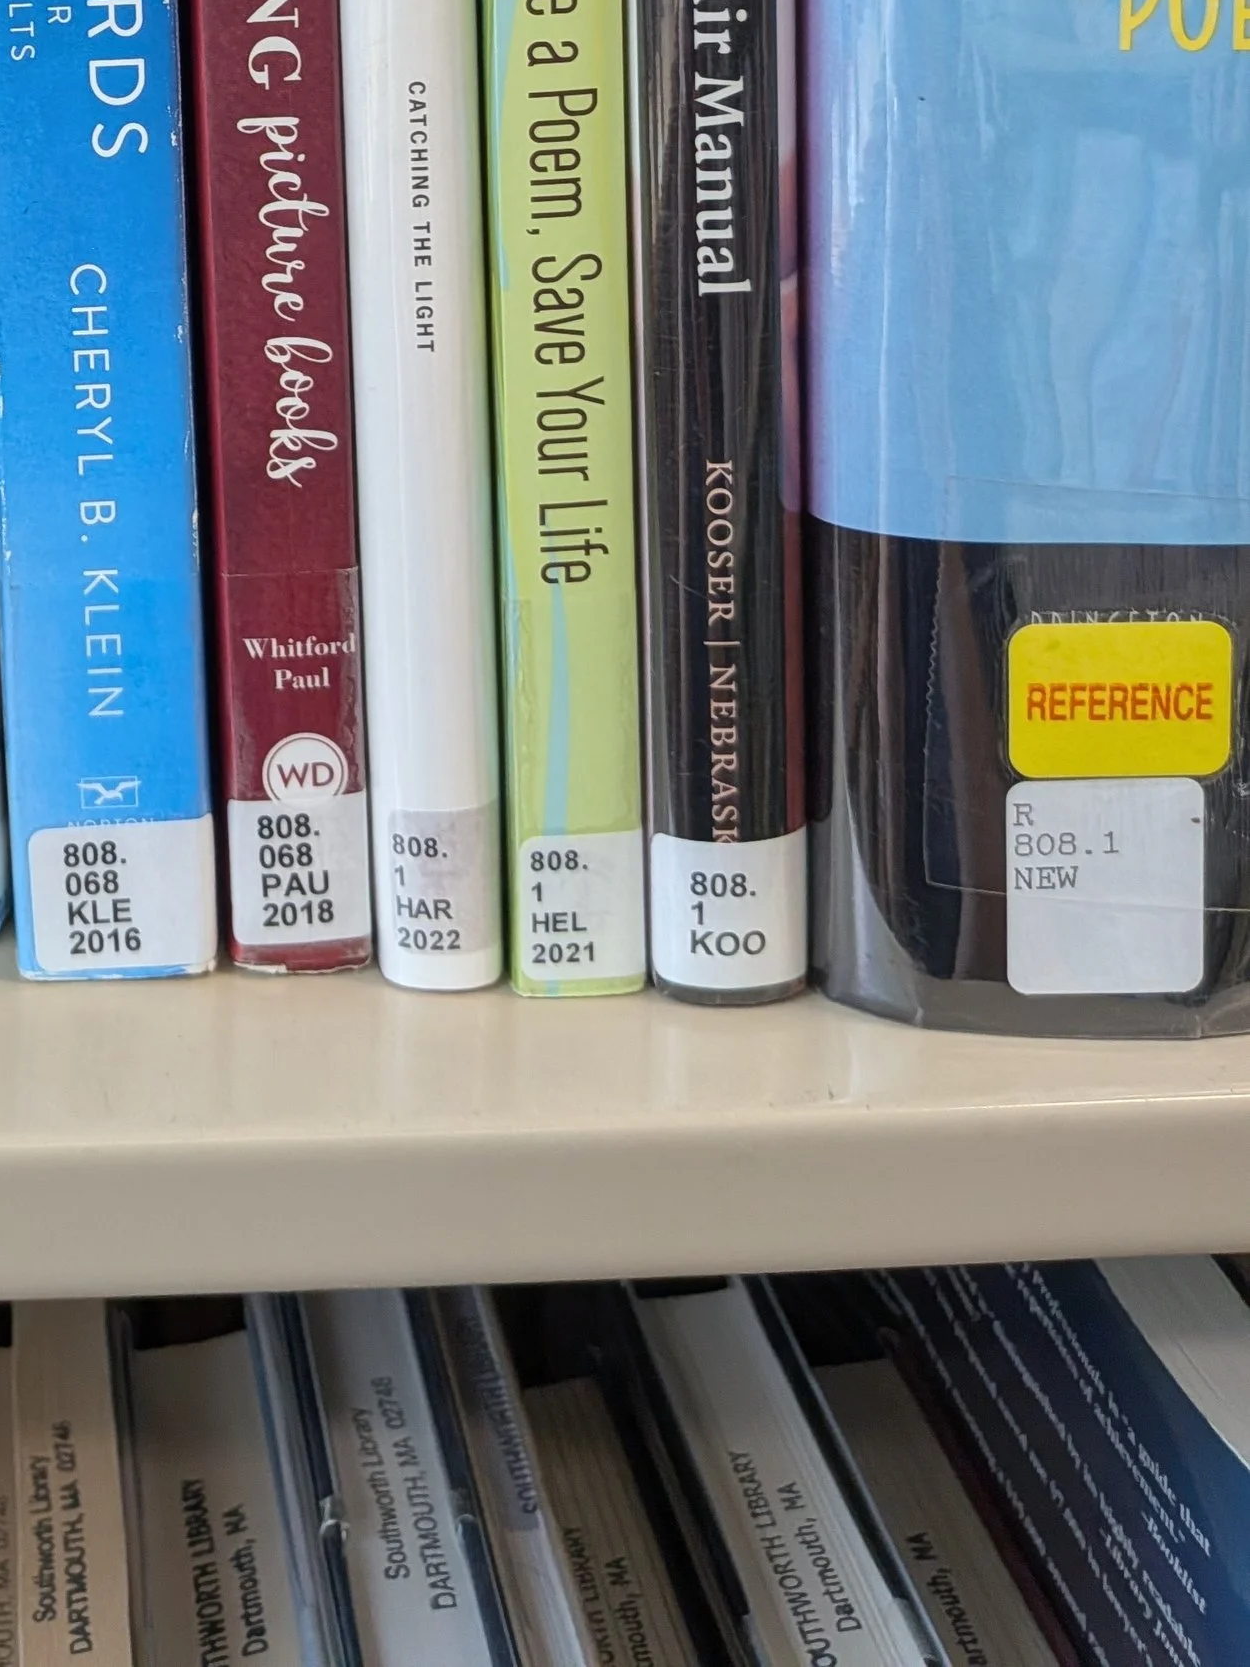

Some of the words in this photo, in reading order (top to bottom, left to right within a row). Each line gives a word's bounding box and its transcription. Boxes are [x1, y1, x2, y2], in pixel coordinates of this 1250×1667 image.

[526, 40, 579, 67] a
[408, 80, 431, 209] CATCHING
[526, 87, 599, 236] Poem,
[694, 73, 753, 298] Manual
[237, 116, 330, 322] picture
[412, 221, 432, 267] THE
[414, 280, 436, 353] LIGHT
[531, 253, 603, 366] Save
[69, 263, 114, 476] CHERYL
[263, 336, 339, 488] books
[535, 376, 606, 482] Your
[79, 500, 116, 544] B.
[538, 498, 610, 585] Life
[705, 458, 738, 626] KOOSER
[82, 569, 124, 718] KLEIN
[243, 633, 356, 659] Whitford
[274, 667, 330, 691] Paul
[1027, 683, 1213, 721] REFERENCE
[277, 762, 335, 789] WD
[257, 814, 320, 840] 808.
[1012, 803, 1034, 827] R
[63, 842, 127, 867] 808.
[259, 843, 313, 868] 068
[392, 834, 448, 859] 808.
[1013, 831, 1120, 857] 808.1
[530, 851, 588, 873] 808.
[65, 869, 120, 894] 068
[262, 871, 330, 898] PAU
[395, 866, 405, 886] 1
[690, 873, 757, 898] 808.
[1015, 866, 1078, 890] NEW
[532, 883, 543, 902] 1
[67, 898, 132, 925] KLE
[263, 900, 334, 927] 2018
[397, 896, 453, 920] HAR
[691, 901, 704, 925] 1
[531, 912, 587, 934] HEL
[70, 928, 141, 955] 2016
[397, 928, 461, 951] 2022
[532, 942, 596, 964] 2021
[690, 930, 767, 957] KOO
[727, 1449, 776, 1539] LIBRARY
[777, 1481, 805, 1511] MA
[360, 1464, 410, 1581] Southworth
[1180, 1503, 1211, 1557] that
[32, 1516, 57, 1623] Southworth
[802, 1515, 863, 1633] Dartmouth,
